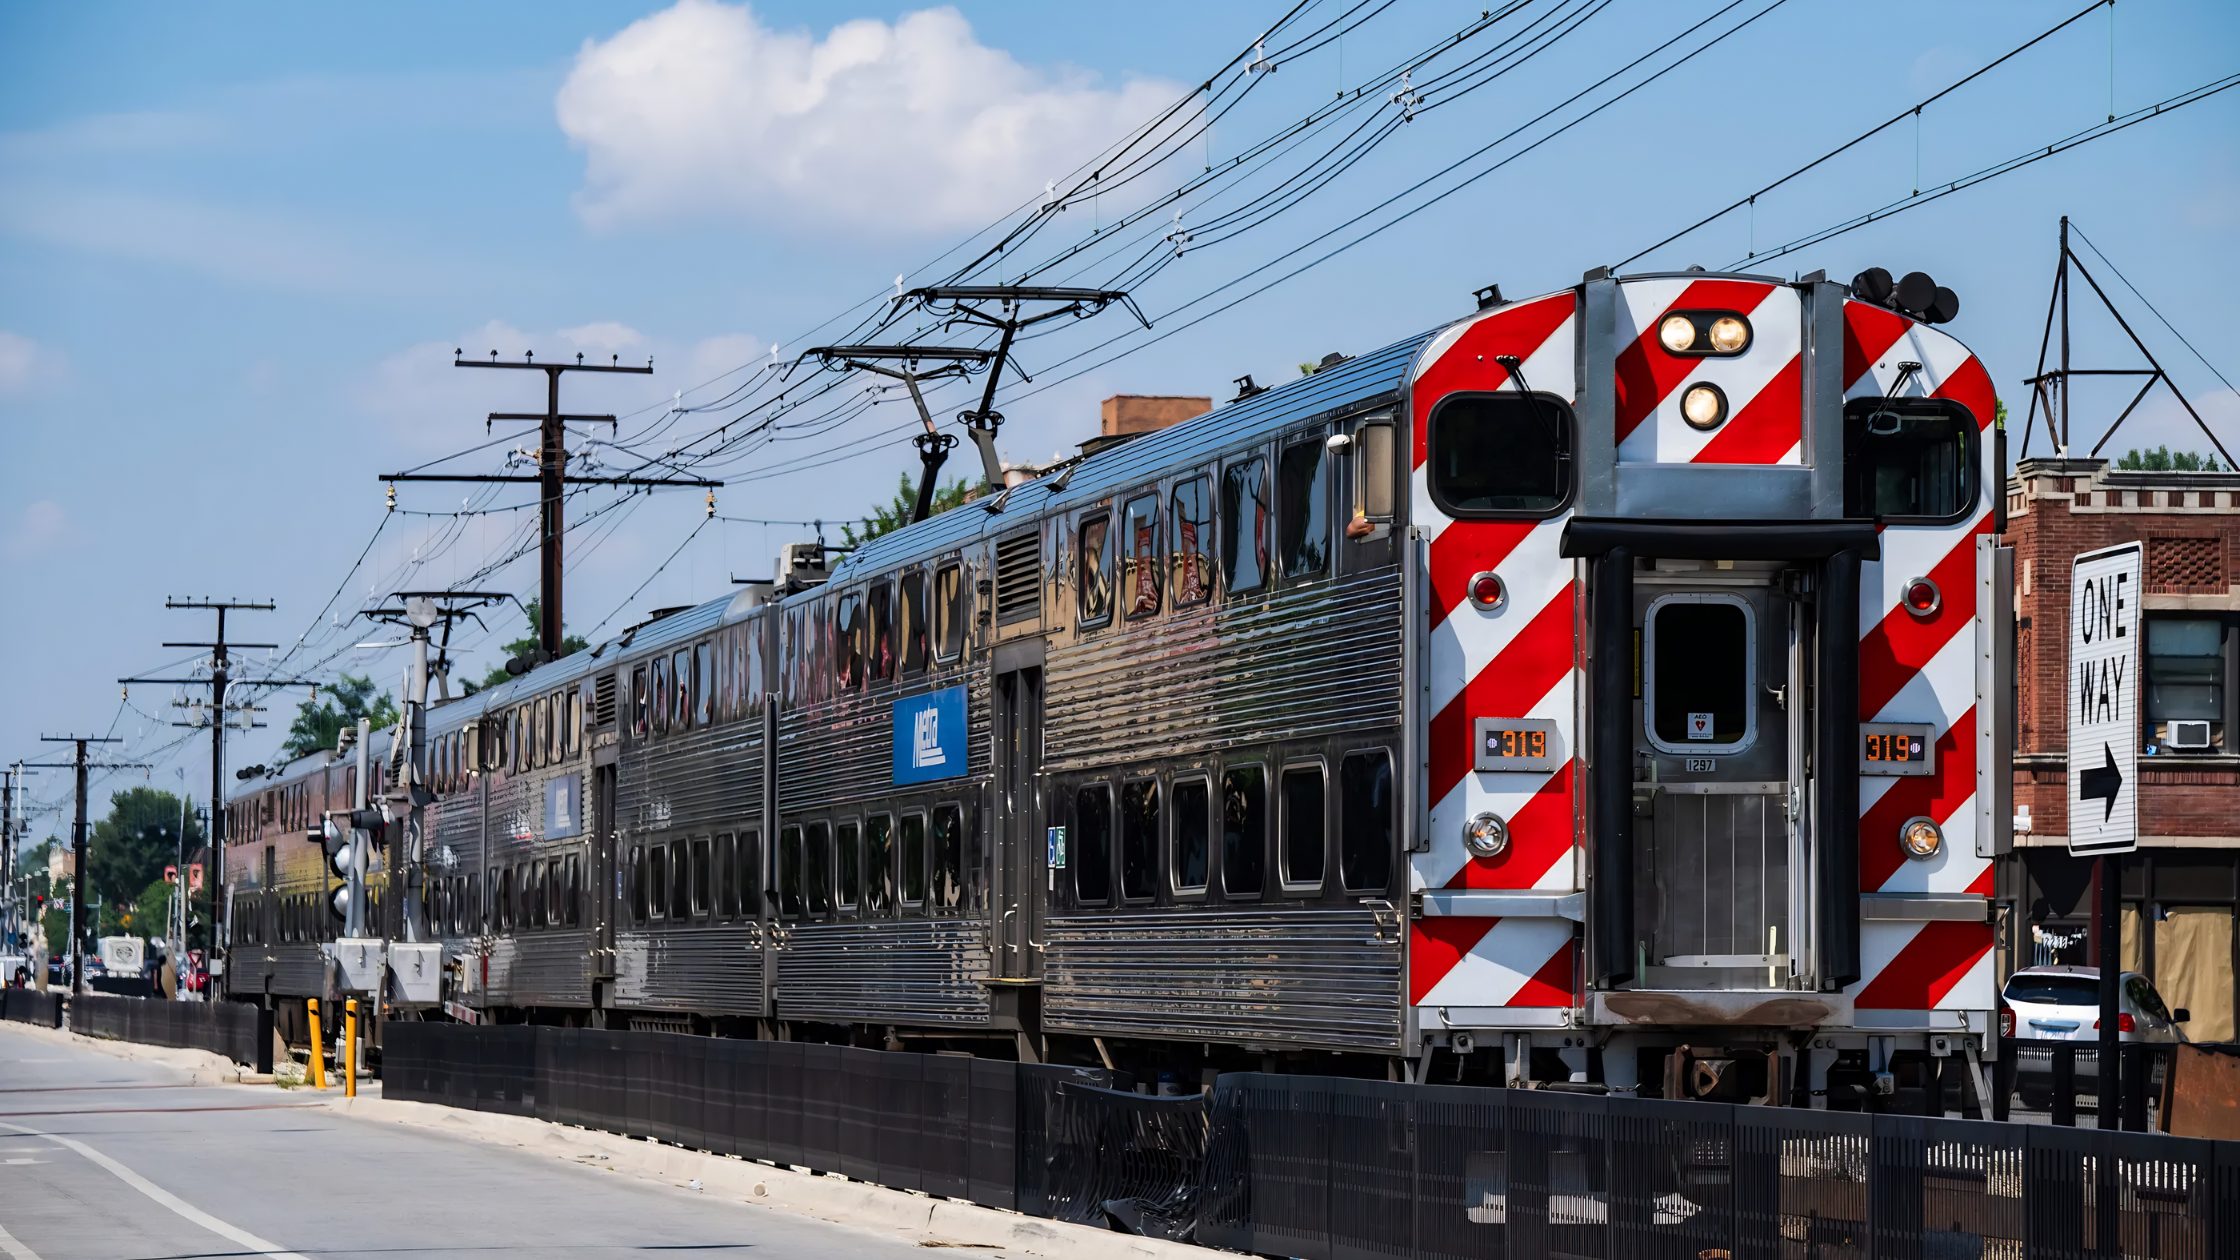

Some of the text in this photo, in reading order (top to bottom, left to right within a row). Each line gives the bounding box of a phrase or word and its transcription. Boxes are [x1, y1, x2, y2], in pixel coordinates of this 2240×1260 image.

[2082, 572, 2128, 644] ONE
[2080, 654, 2126, 726] WAY
[913, 703, 945, 768] Metra
[1502, 731, 1545, 757] 319
[1867, 735, 1909, 761] 319
[1689, 760, 1713, 771] 1297
